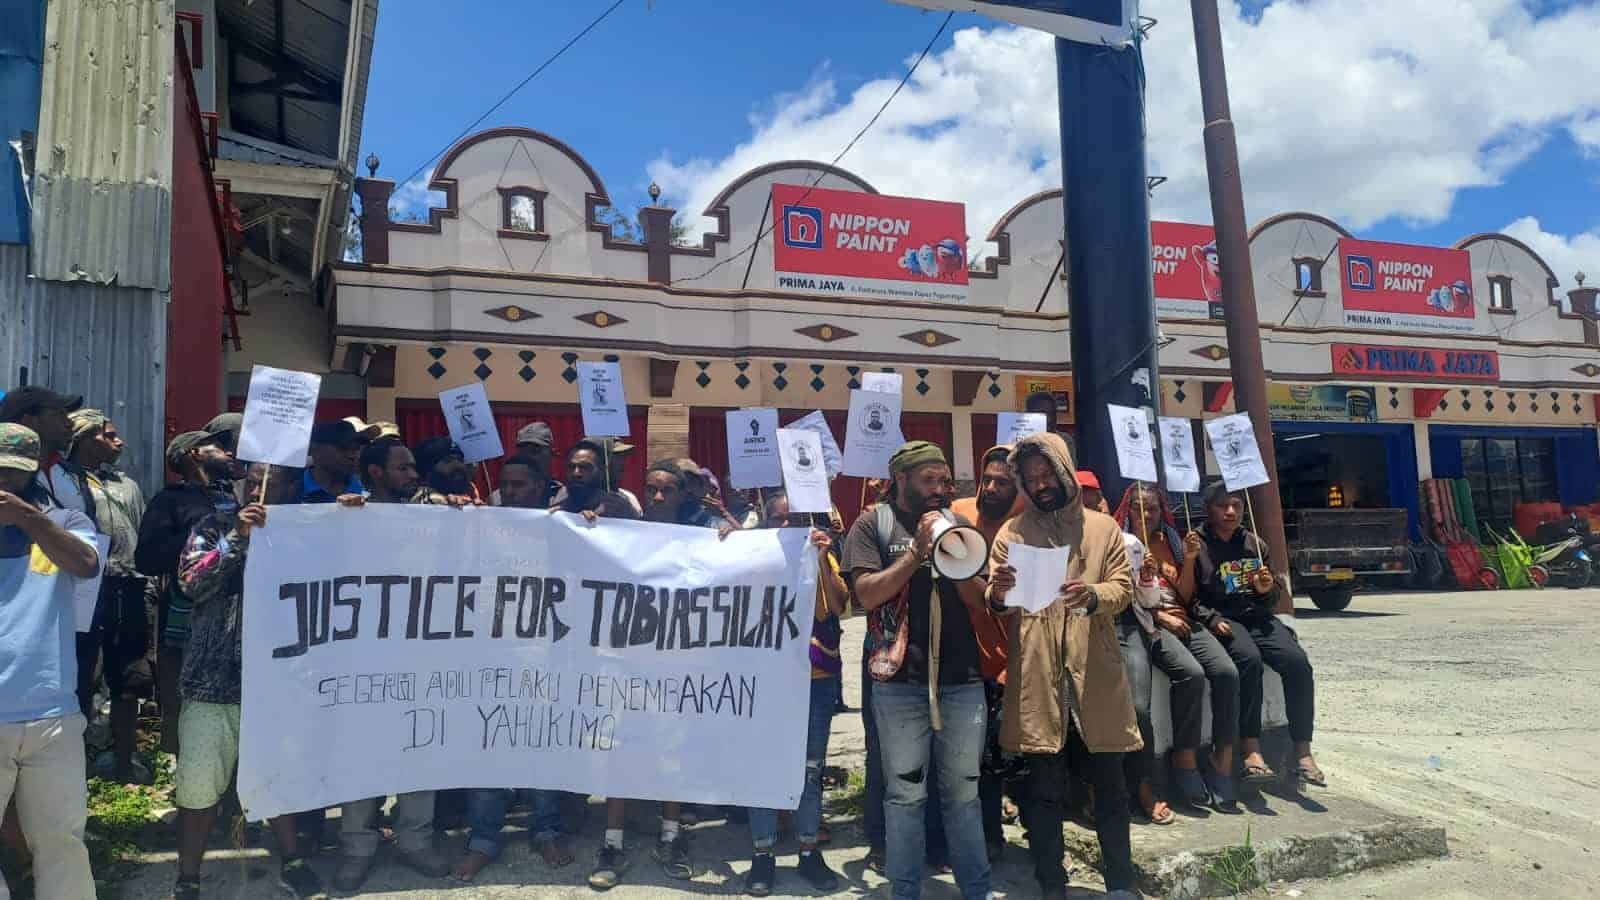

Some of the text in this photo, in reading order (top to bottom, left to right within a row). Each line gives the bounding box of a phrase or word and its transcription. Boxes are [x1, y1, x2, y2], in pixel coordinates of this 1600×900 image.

[829, 212, 911, 235] NIPPON
[836, 232, 899, 253] PAINT
[1153, 244, 1187, 261] PON
[1153, 260, 1179, 275] INT
[1378, 261, 1433, 278] NIPPON
[779, 277, 845, 291] PRIMA JAYA
[1384, 277, 1426, 292] PAINT
[1347, 314, 1372, 324] PRIMA
[1374, 315, 1392, 326] JAYA
[1366, 347, 1496, 375] PRIMA JAYA
[272, 575, 482, 659] JUSTICE
[491, 575, 571, 643] FOR
[478, 667, 561, 702] PELAKU
[578, 672, 756, 719] PENEMBAKAN
[402, 704, 616, 752] DI YAHUKIMO
